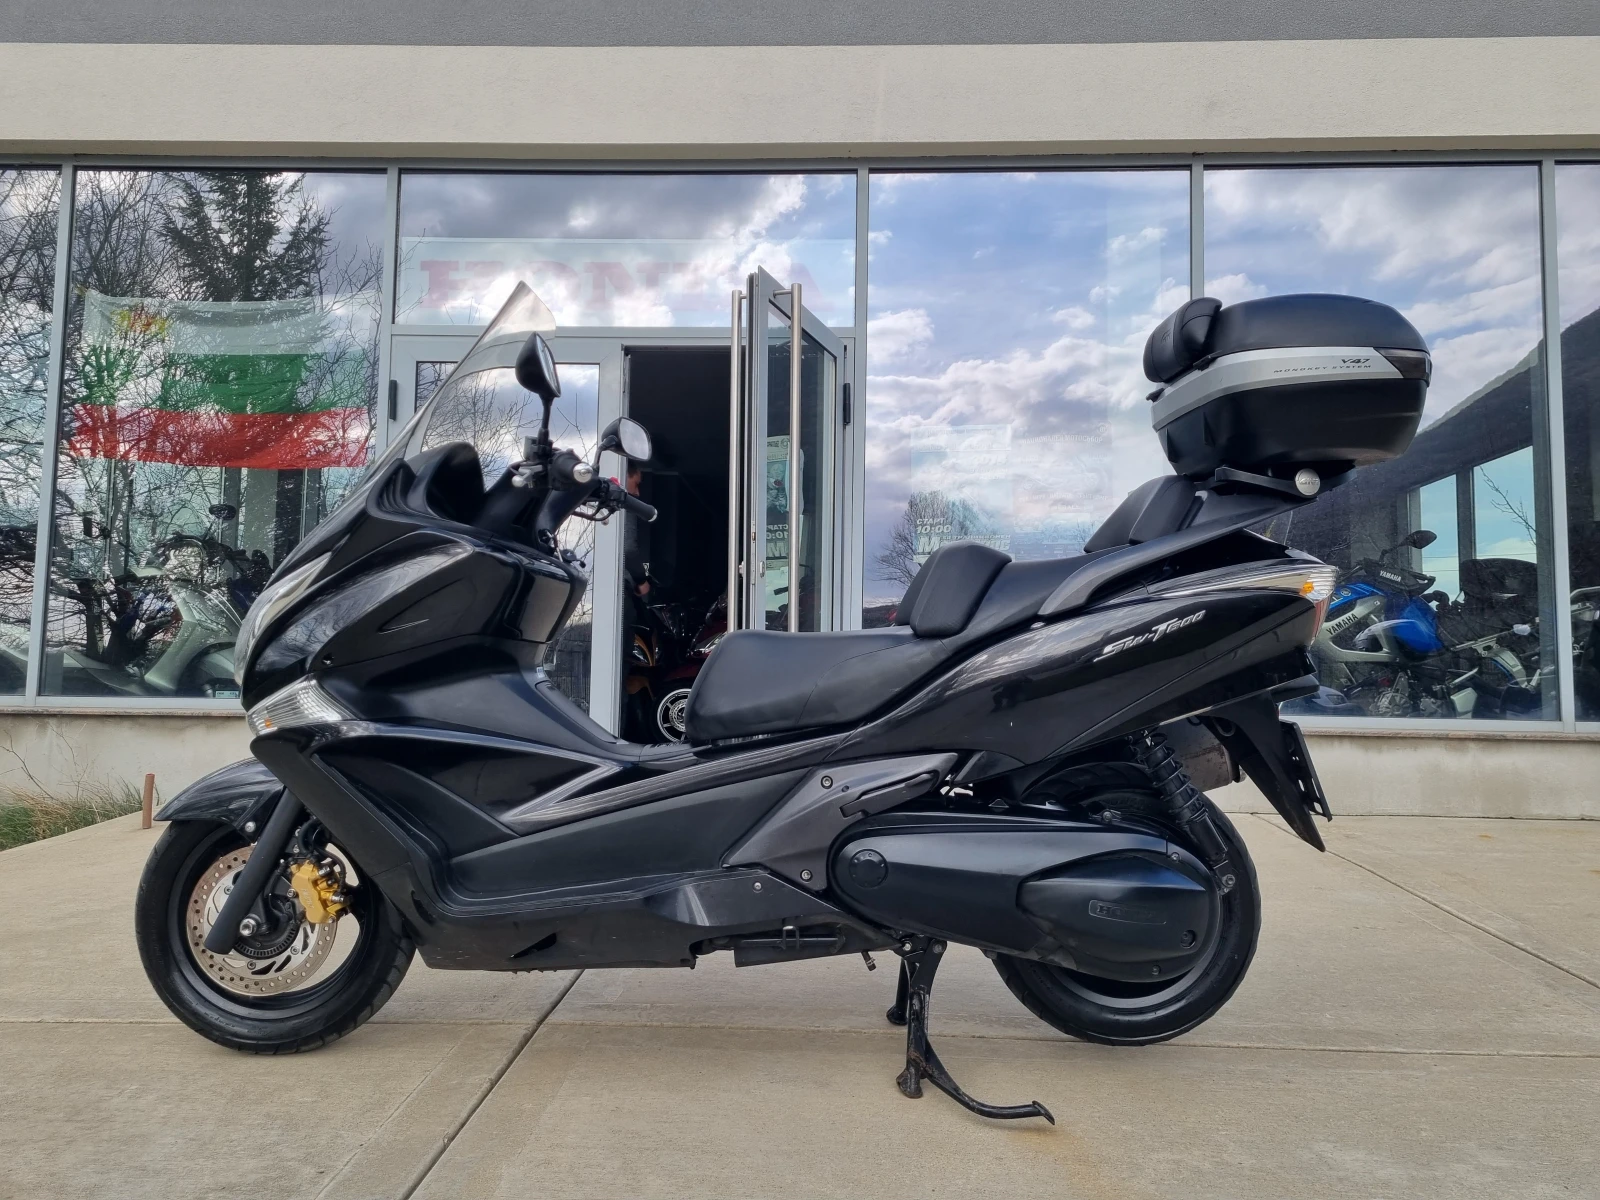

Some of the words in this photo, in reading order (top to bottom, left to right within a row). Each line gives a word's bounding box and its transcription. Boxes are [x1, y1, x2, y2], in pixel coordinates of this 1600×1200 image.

[1273, 365, 1328, 374] MONOKEY
[916, 517, 946, 525] СТАРТ
[916, 524, 952, 534] 10:00
[1379, 570, 1402, 582] YAMAHA
[1326, 613, 1359, 636] YAMAHA
